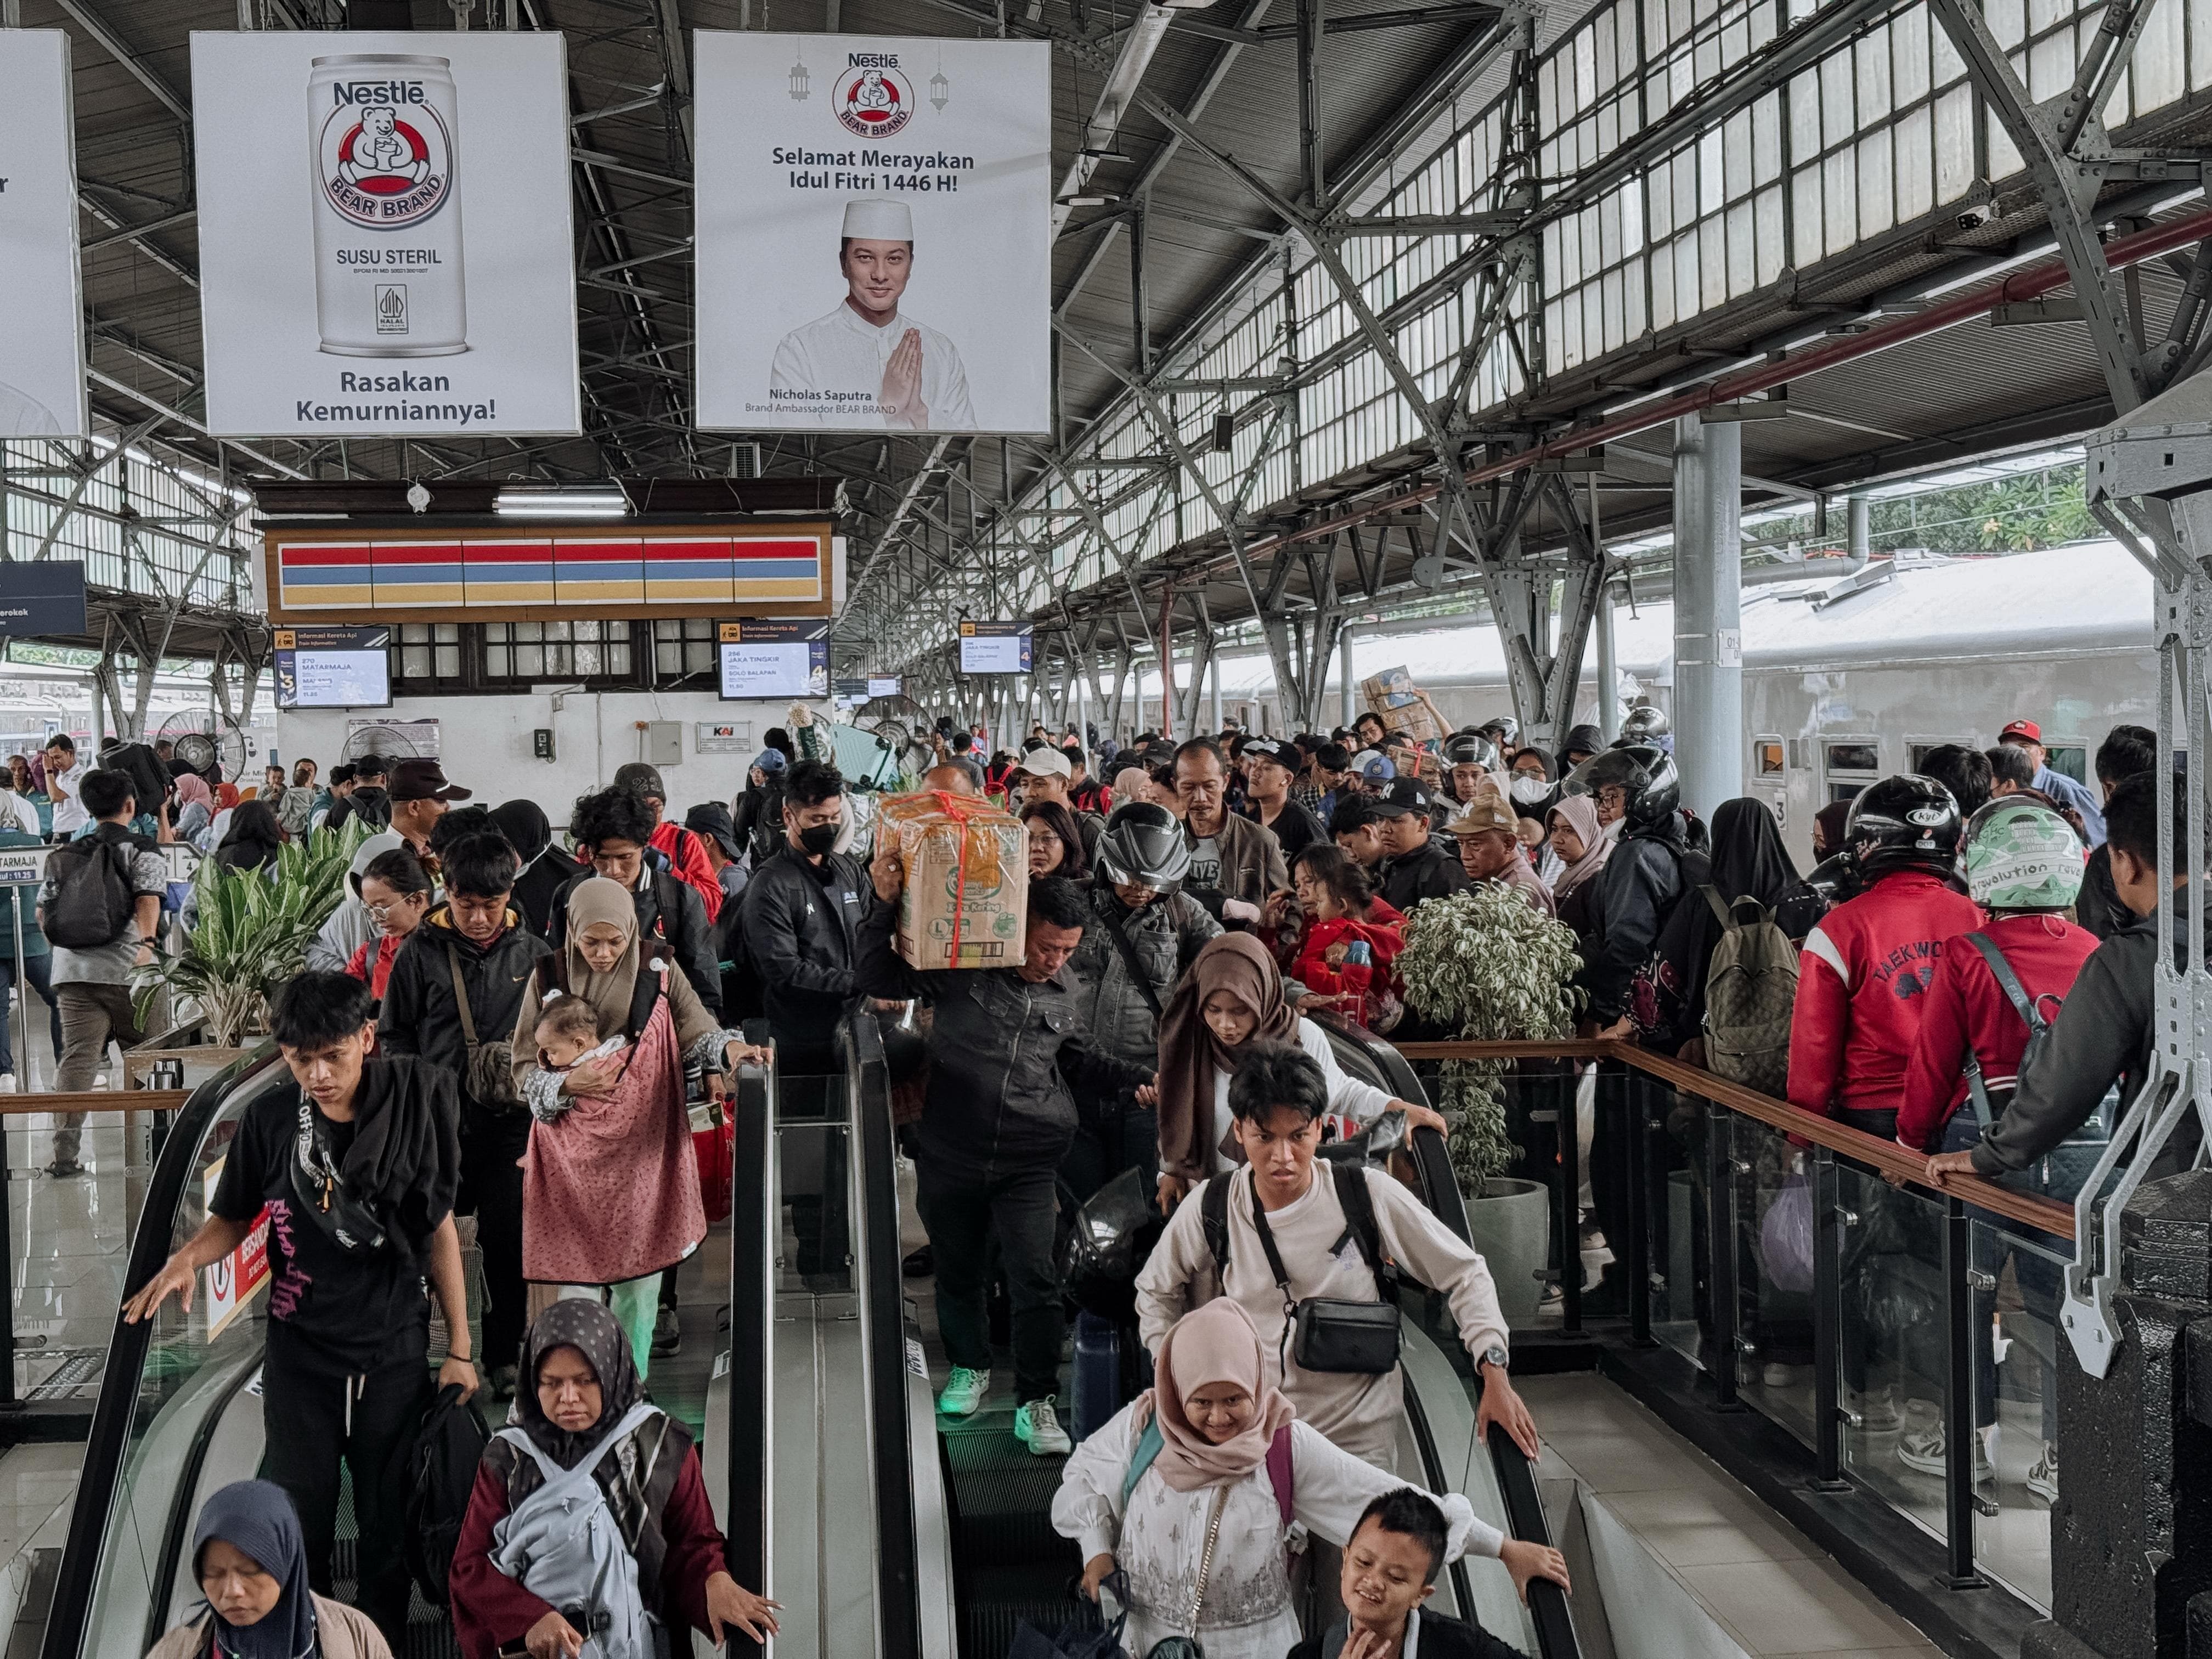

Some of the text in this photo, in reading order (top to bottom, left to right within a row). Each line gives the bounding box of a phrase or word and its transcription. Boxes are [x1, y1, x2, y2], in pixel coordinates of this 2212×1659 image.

[840, 110, 907, 136] BEAR BRAND
[772, 147, 974, 172] Selamat Merayakan
[790, 171, 958, 192] Idul Fitri 1446 H!
[330, 175, 442, 217] BEAR BRAND
[336, 249, 442, 264] SUSU STERIL
[296, 370, 496, 426] Rasakan Kemurniannya!
[769, 388, 872, 403] Nicholas Saputra
[745, 403, 897, 414] Brand Ambassador BEAR BRAND
[713, 726, 734, 736] KAI
[970, 901, 1001, 913] Kering
